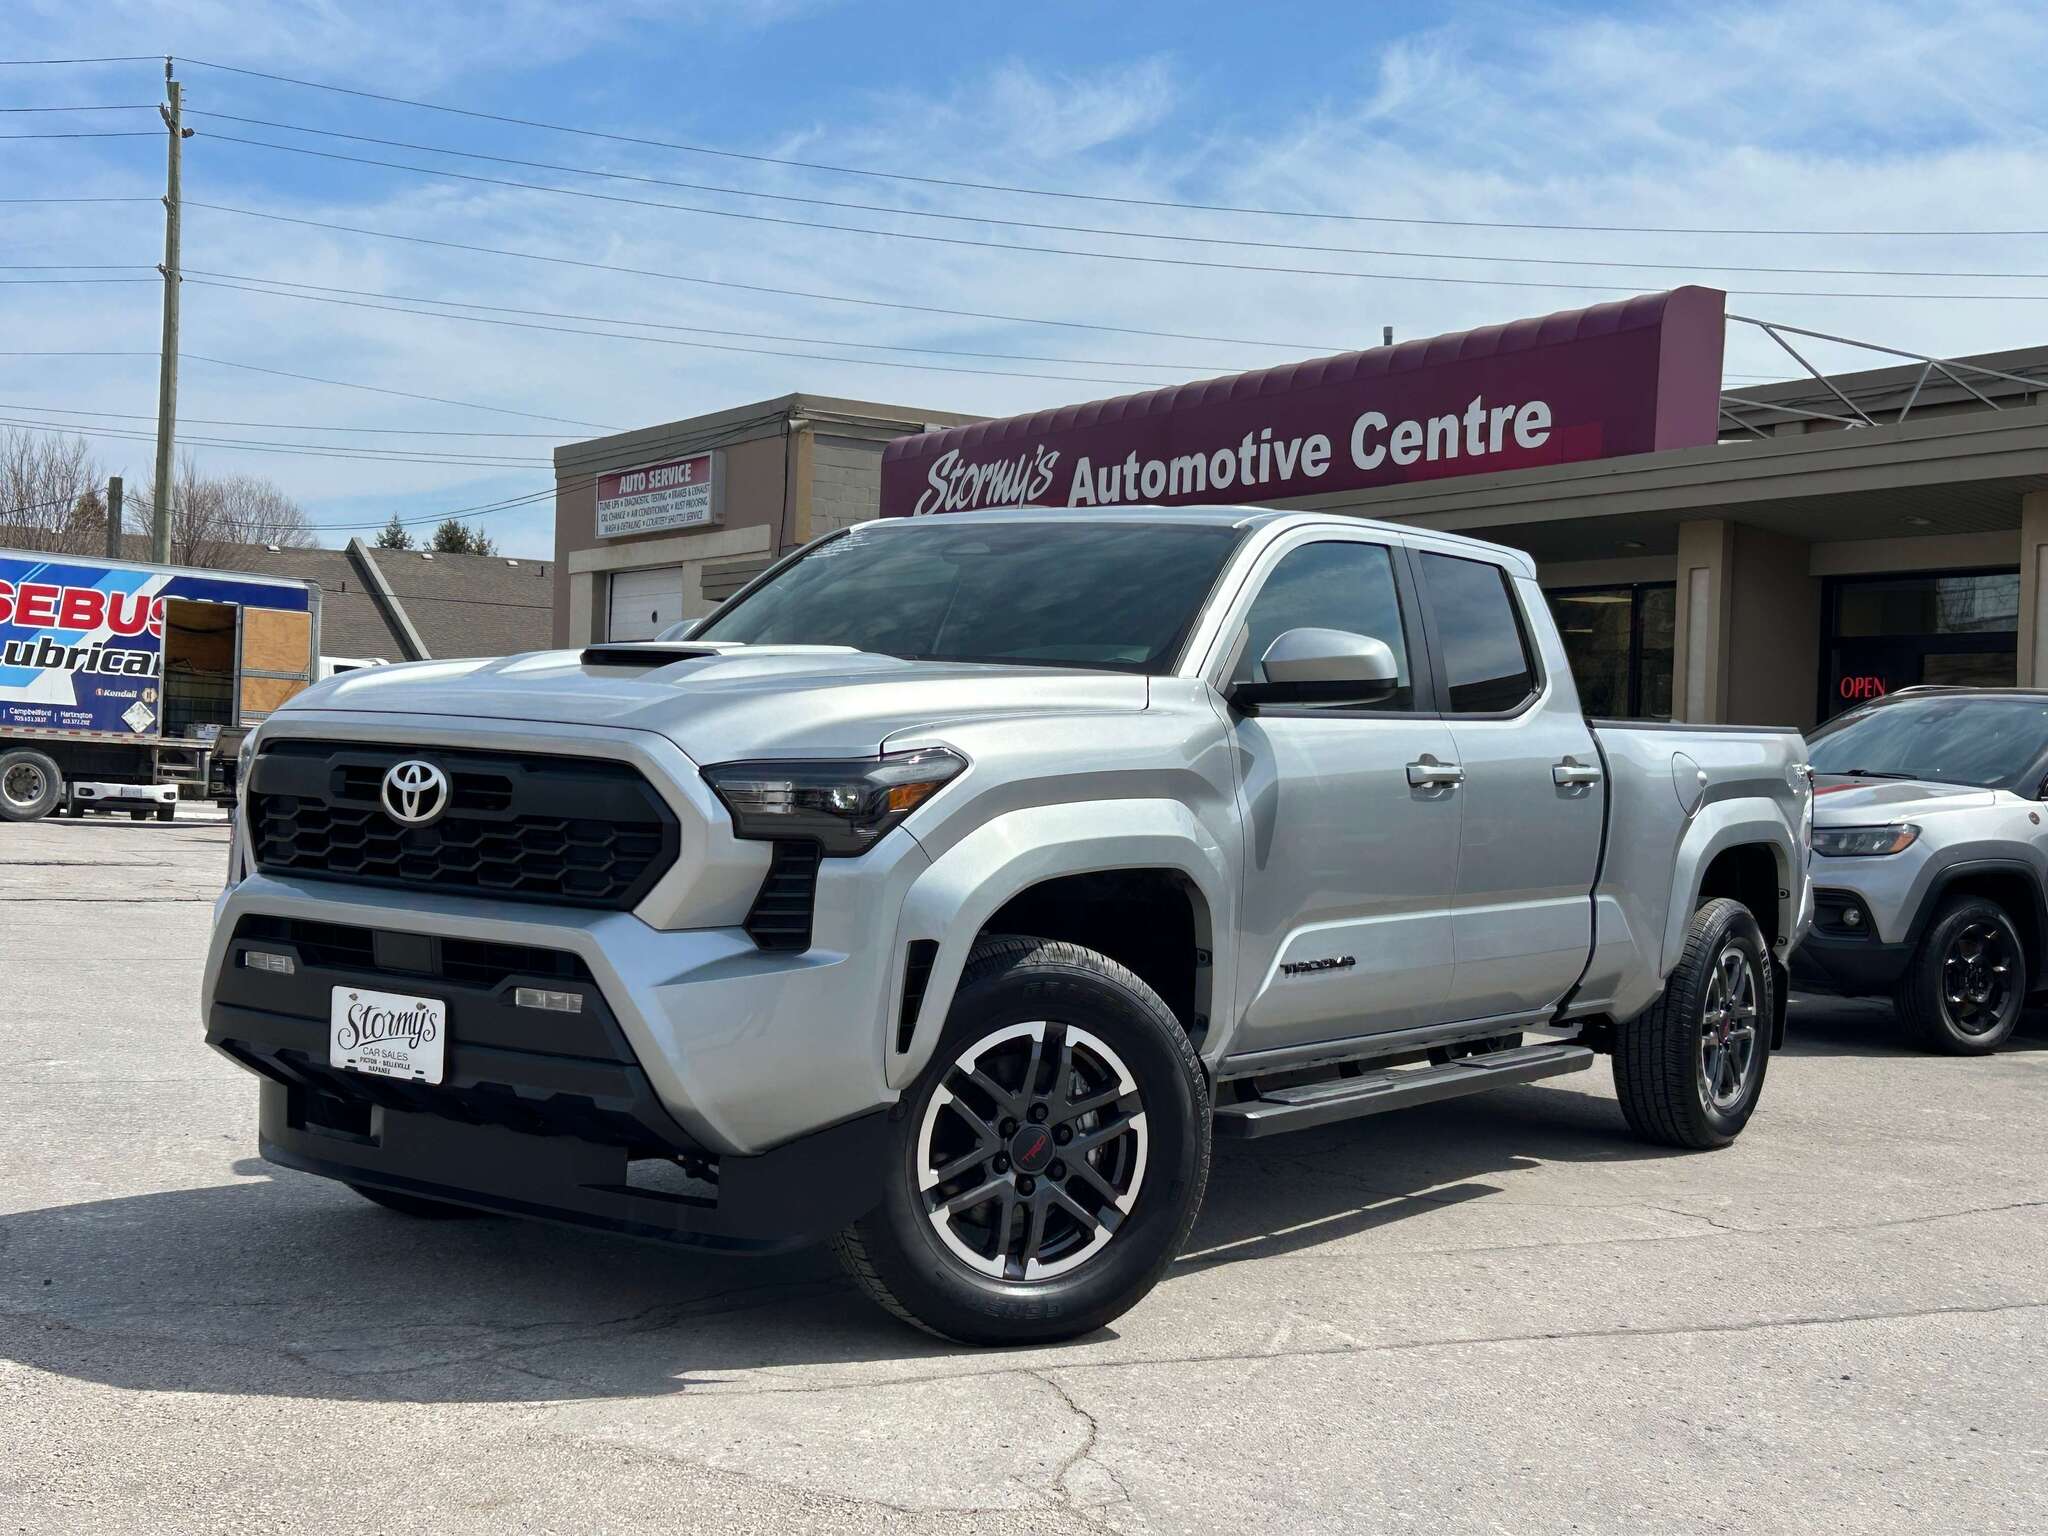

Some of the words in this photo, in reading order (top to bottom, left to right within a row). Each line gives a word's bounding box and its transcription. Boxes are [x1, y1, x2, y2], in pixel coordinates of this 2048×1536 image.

[914, 444, 1060, 517] Stormy's
[1069, 428, 1331, 508] Automotive
[1350, 395, 1552, 471] Centre
[618, 472, 646, 494] AUTO
[649, 464, 692, 489] SERVICE
[624, 495, 649, 508] DIAGNOSTIC
[651, 492, 667, 503] TESTING
[608, 510, 626, 521] CHANGE
[0, 635, 160, 677] ubrica
[104, 689, 137, 698] Kendall
[1840, 676, 1886, 698] OPEN
[338, 1003, 437, 1050] Stormy's
[363, 1047, 380, 1057] CAR
[382, 1048, 408, 1062] SALES
[382, 1060, 410, 1070] BELLEVILLE
